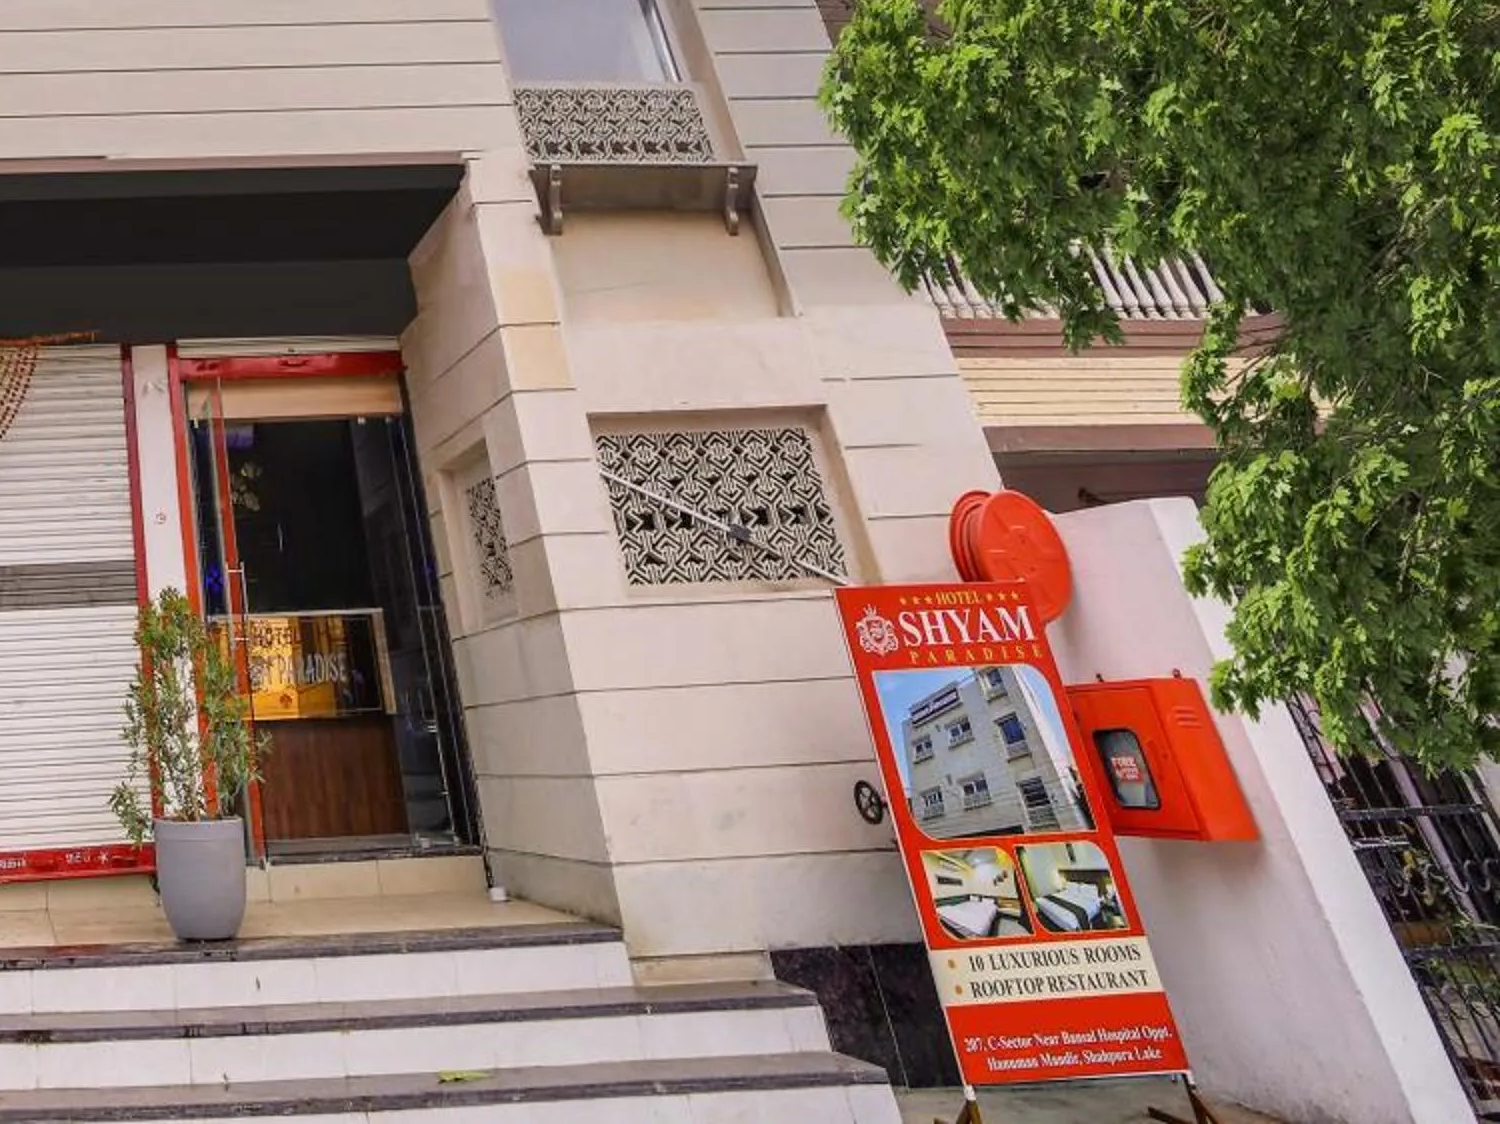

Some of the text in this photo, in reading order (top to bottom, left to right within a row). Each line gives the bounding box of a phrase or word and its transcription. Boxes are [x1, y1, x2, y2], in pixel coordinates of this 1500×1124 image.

[935, 590, 982, 605] HOTEL
[898, 605, 1037, 647] SHYAM
[909, 643, 1044, 665] PARADISE
[968, 943, 1142, 972] 10 LUXURIOUS ROOMS
[970, 970, 1149, 999] ROOFTOP RESTAURANT
[1033, 1033, 1060, 1046] Near
[1134, 1045, 1162, 1060] Lake
